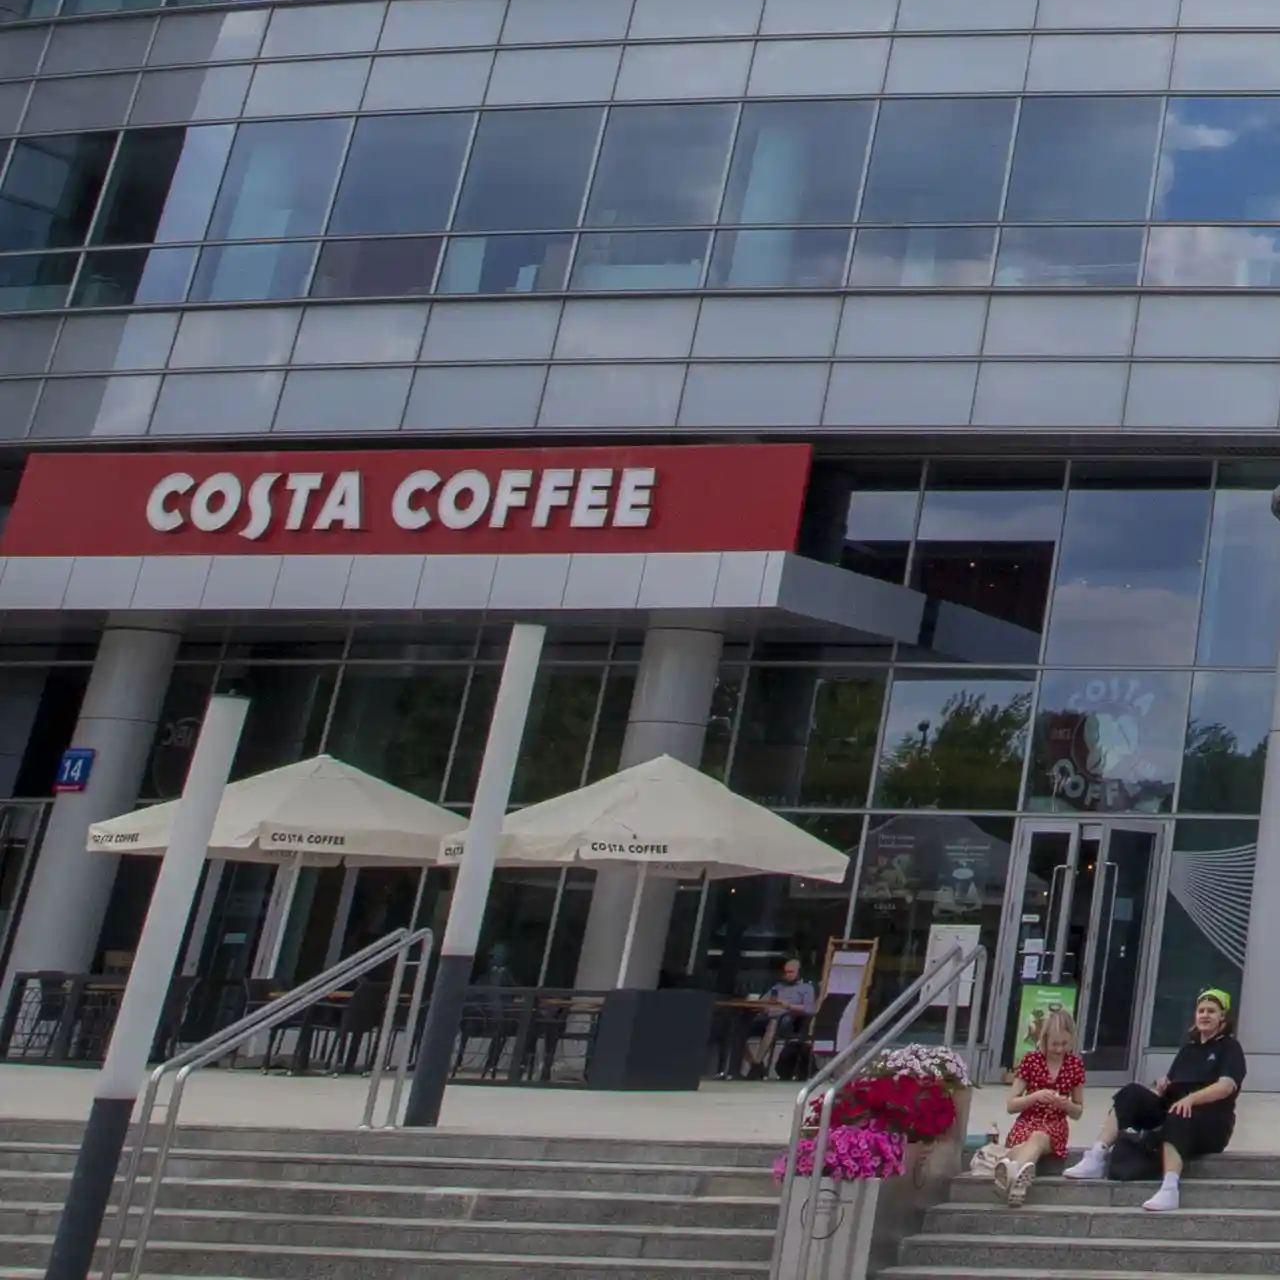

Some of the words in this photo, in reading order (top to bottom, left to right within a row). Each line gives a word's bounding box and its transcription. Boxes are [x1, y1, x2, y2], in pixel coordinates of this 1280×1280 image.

[145, 470, 364, 539] COSTA
[391, 467, 655, 530] COFFEE
[63, 758, 84, 781] 14
[271, 831, 303, 844] COSTA
[307, 834, 345, 846] COFFEE
[591, 842, 625, 853] COSTA
[628, 844, 669, 855] COFFEE
